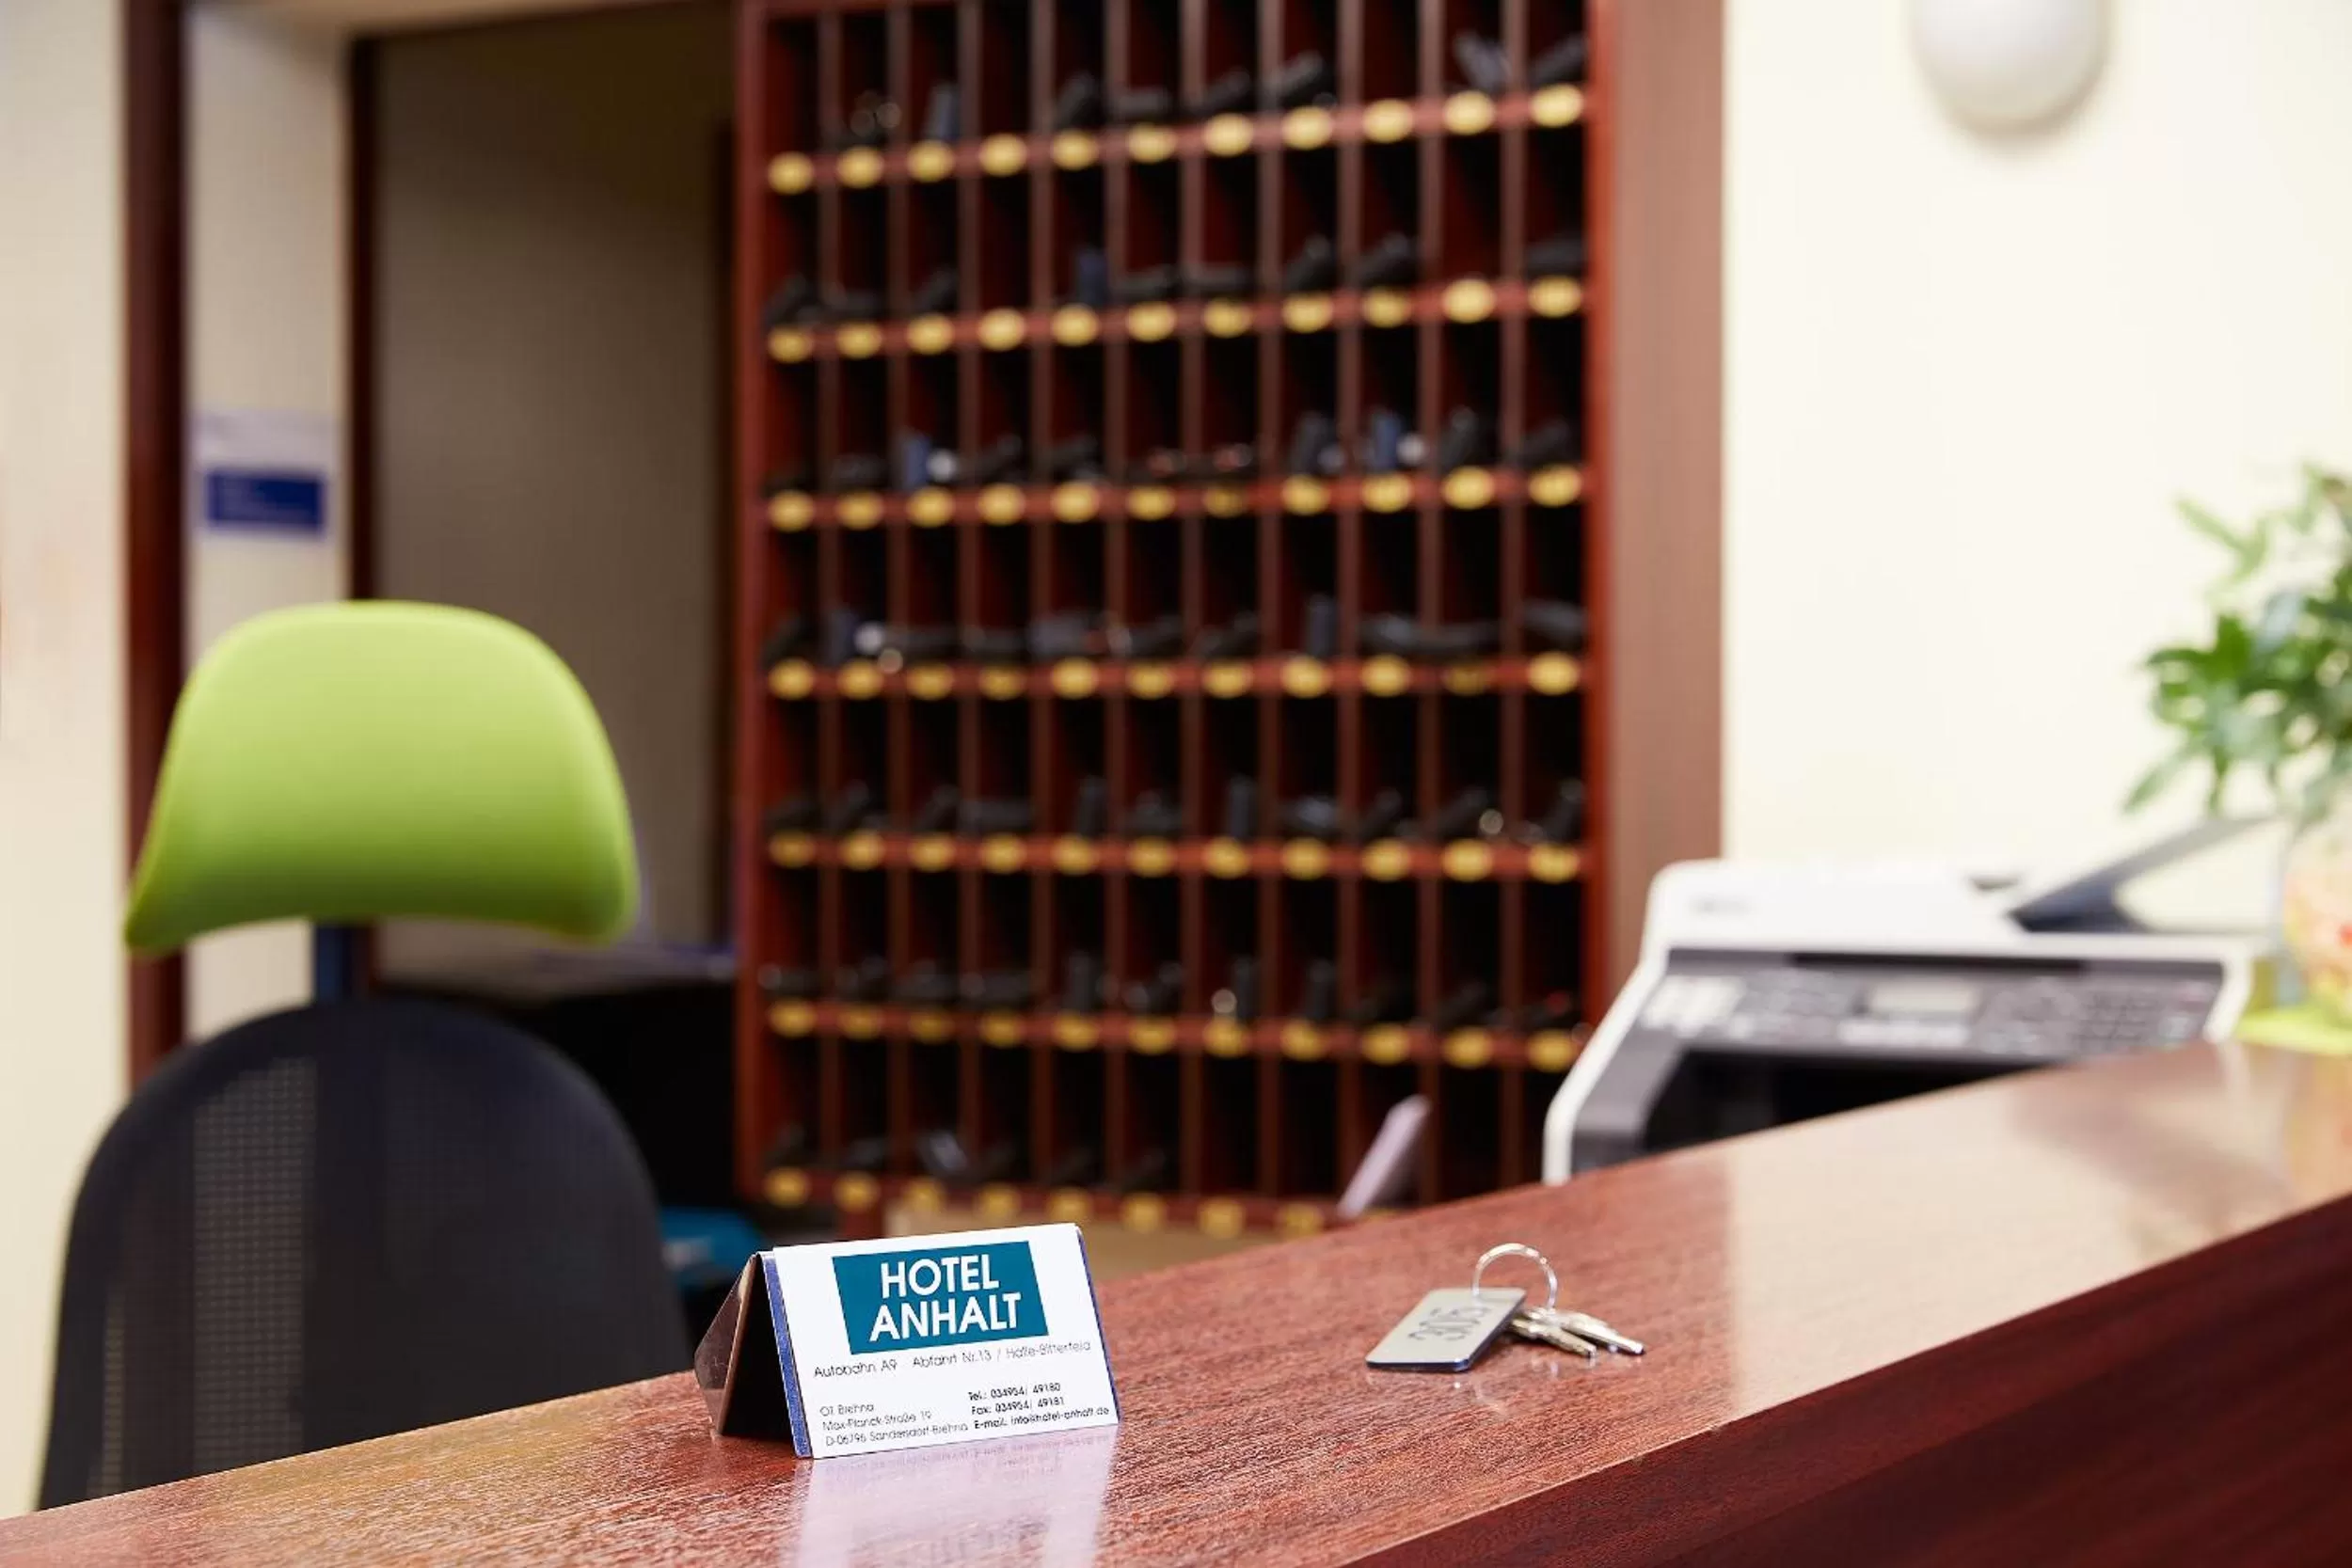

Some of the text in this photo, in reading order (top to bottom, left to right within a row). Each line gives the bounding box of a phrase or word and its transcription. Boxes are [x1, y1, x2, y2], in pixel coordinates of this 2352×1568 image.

[881, 1254, 1000, 1299] HOTEL
[868, 1292, 1023, 1343] ANHALT
[813, 1362, 877, 1378] Autobahn
[881, 1358, 898, 1371] A9
[913, 1352, 957, 1368] Abfahrt
